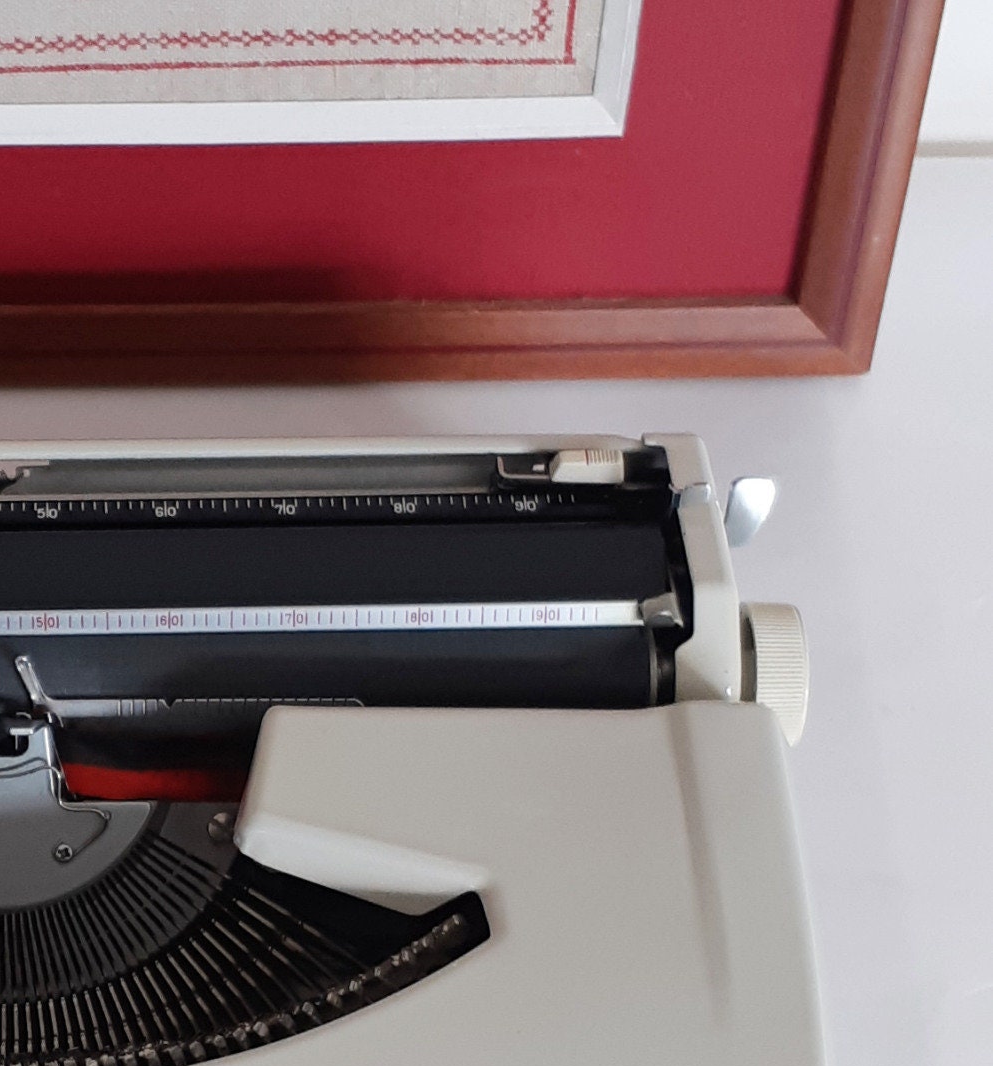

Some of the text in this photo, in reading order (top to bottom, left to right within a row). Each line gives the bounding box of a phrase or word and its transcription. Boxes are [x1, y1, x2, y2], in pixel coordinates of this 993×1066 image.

[37, 509, 58, 519] 50
[155, 507, 177, 518] 60
[275, 504, 296, 515] 70
[393, 503, 415, 514] 80
[514, 501, 537, 512] 90
[36, 617, 56, 628] 50
[160, 616, 180, 627] 60
[284, 613, 305, 624] 70
[410, 612, 430, 623] 80
[535, 609, 557, 620] 90
